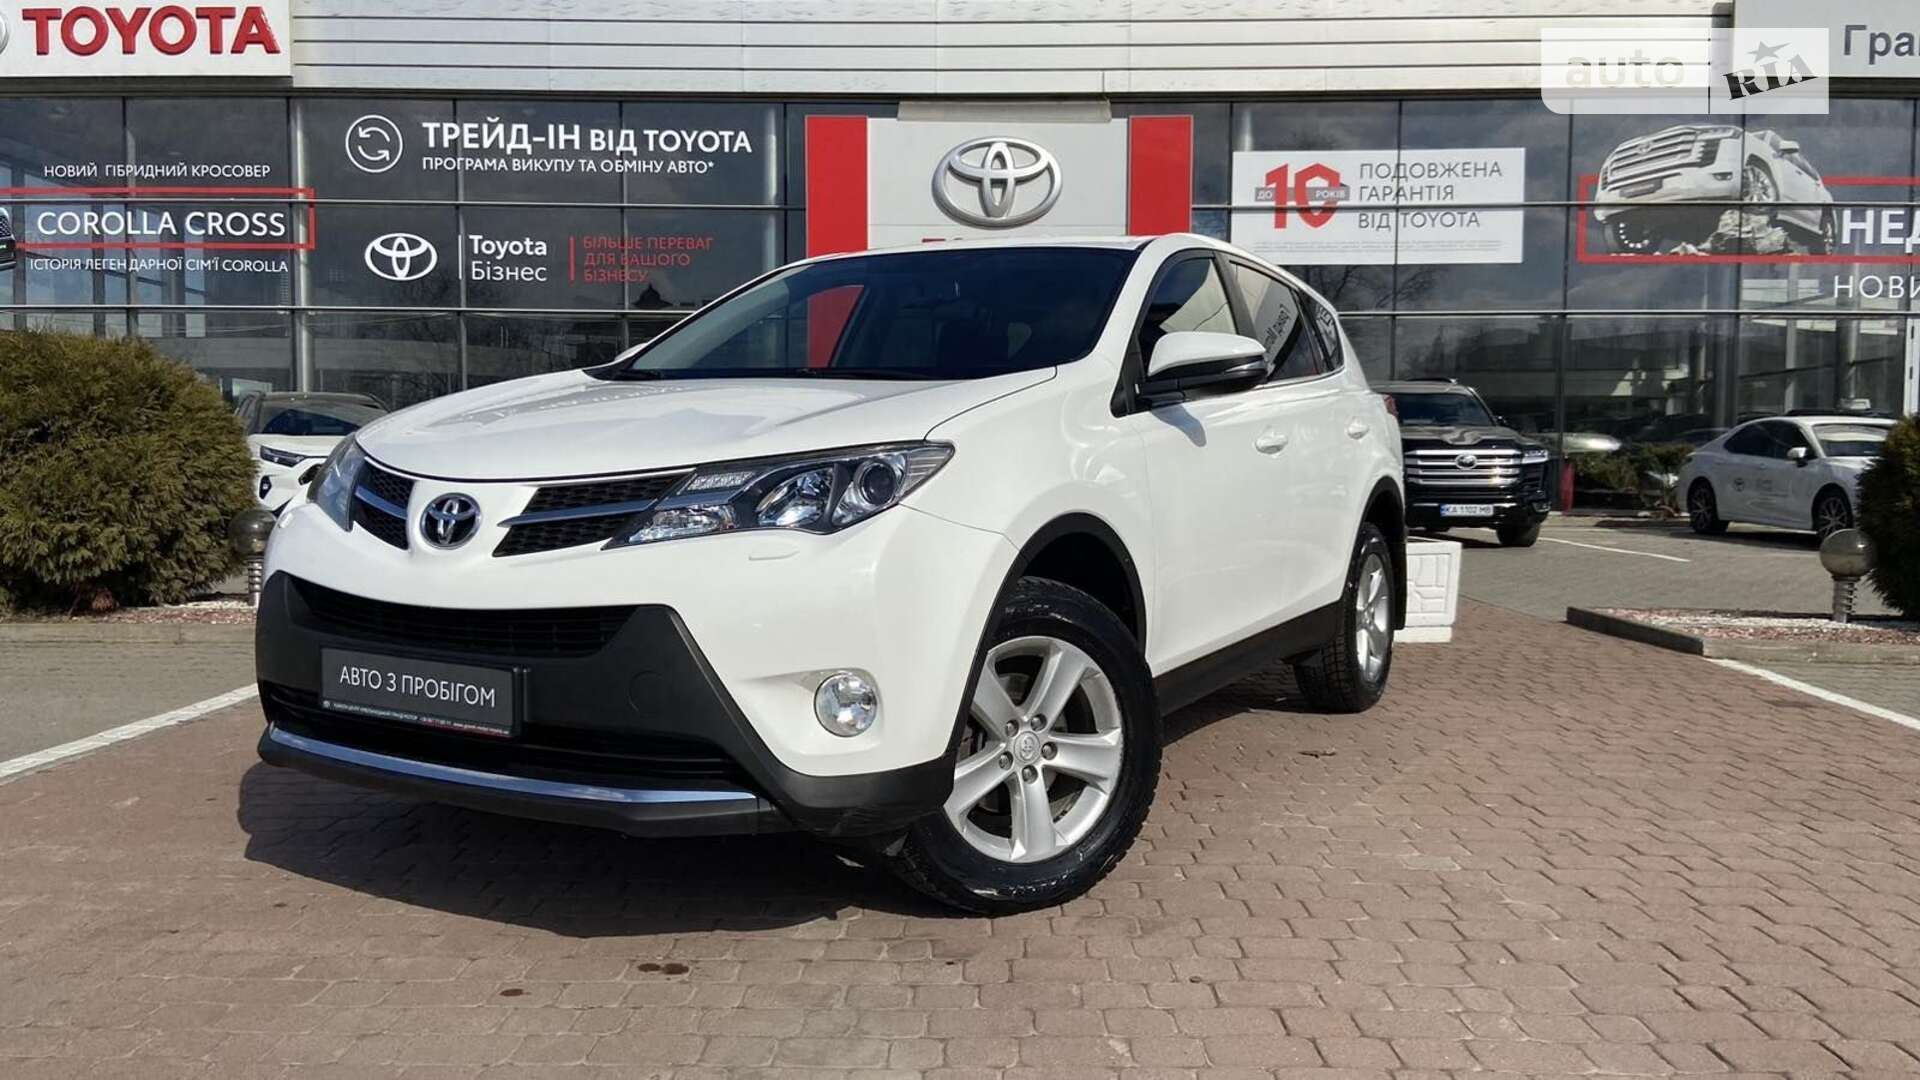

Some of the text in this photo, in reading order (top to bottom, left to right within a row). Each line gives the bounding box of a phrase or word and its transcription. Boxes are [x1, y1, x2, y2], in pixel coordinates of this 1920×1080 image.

[22, 5, 282, 56] TOYOTA
[1844, 25, 1920, 65] Гра
[422, 116, 752, 156] ТРЕЙД-ІН ВІД TOYOTA
[44, 162, 271, 179] НОВИЙ ГІБРИДНИЙ КРОСОВЕР
[422, 157, 508, 173] ПРОГРАМА
[512, 158, 576, 173] ВИКУПУ
[578, 159, 598, 173] ТА
[601, 159, 664, 174] ОБМІНУ
[1359, 162, 1503, 180] ПОДОВЖЕНА
[1257, 191, 1273, 200] ДО
[1265, 163, 1341, 229] 10
[1359, 186, 1454, 201] ГАРАНТІЯ
[37, 210, 286, 237] COROLLA CROSS
[1358, 212, 1481, 231] ВІД TOYOTA
[469, 234, 548, 260] Toyota
[583, 236, 713, 250] БІЛЬШЕ ПЕРЕВАГ
[30, 258, 82, 272] ІСТОРІЯ
[222, 259, 288, 273] COROLLA
[584, 253, 690, 266] ДЛЯ ВАШОГО
[471, 261, 547, 282] Бізнес
[584, 269, 649, 282] БІЗНЕСУ
[340, 665, 383, 690] АВТО
[402, 674, 496, 708] ПРОБІГОМ
